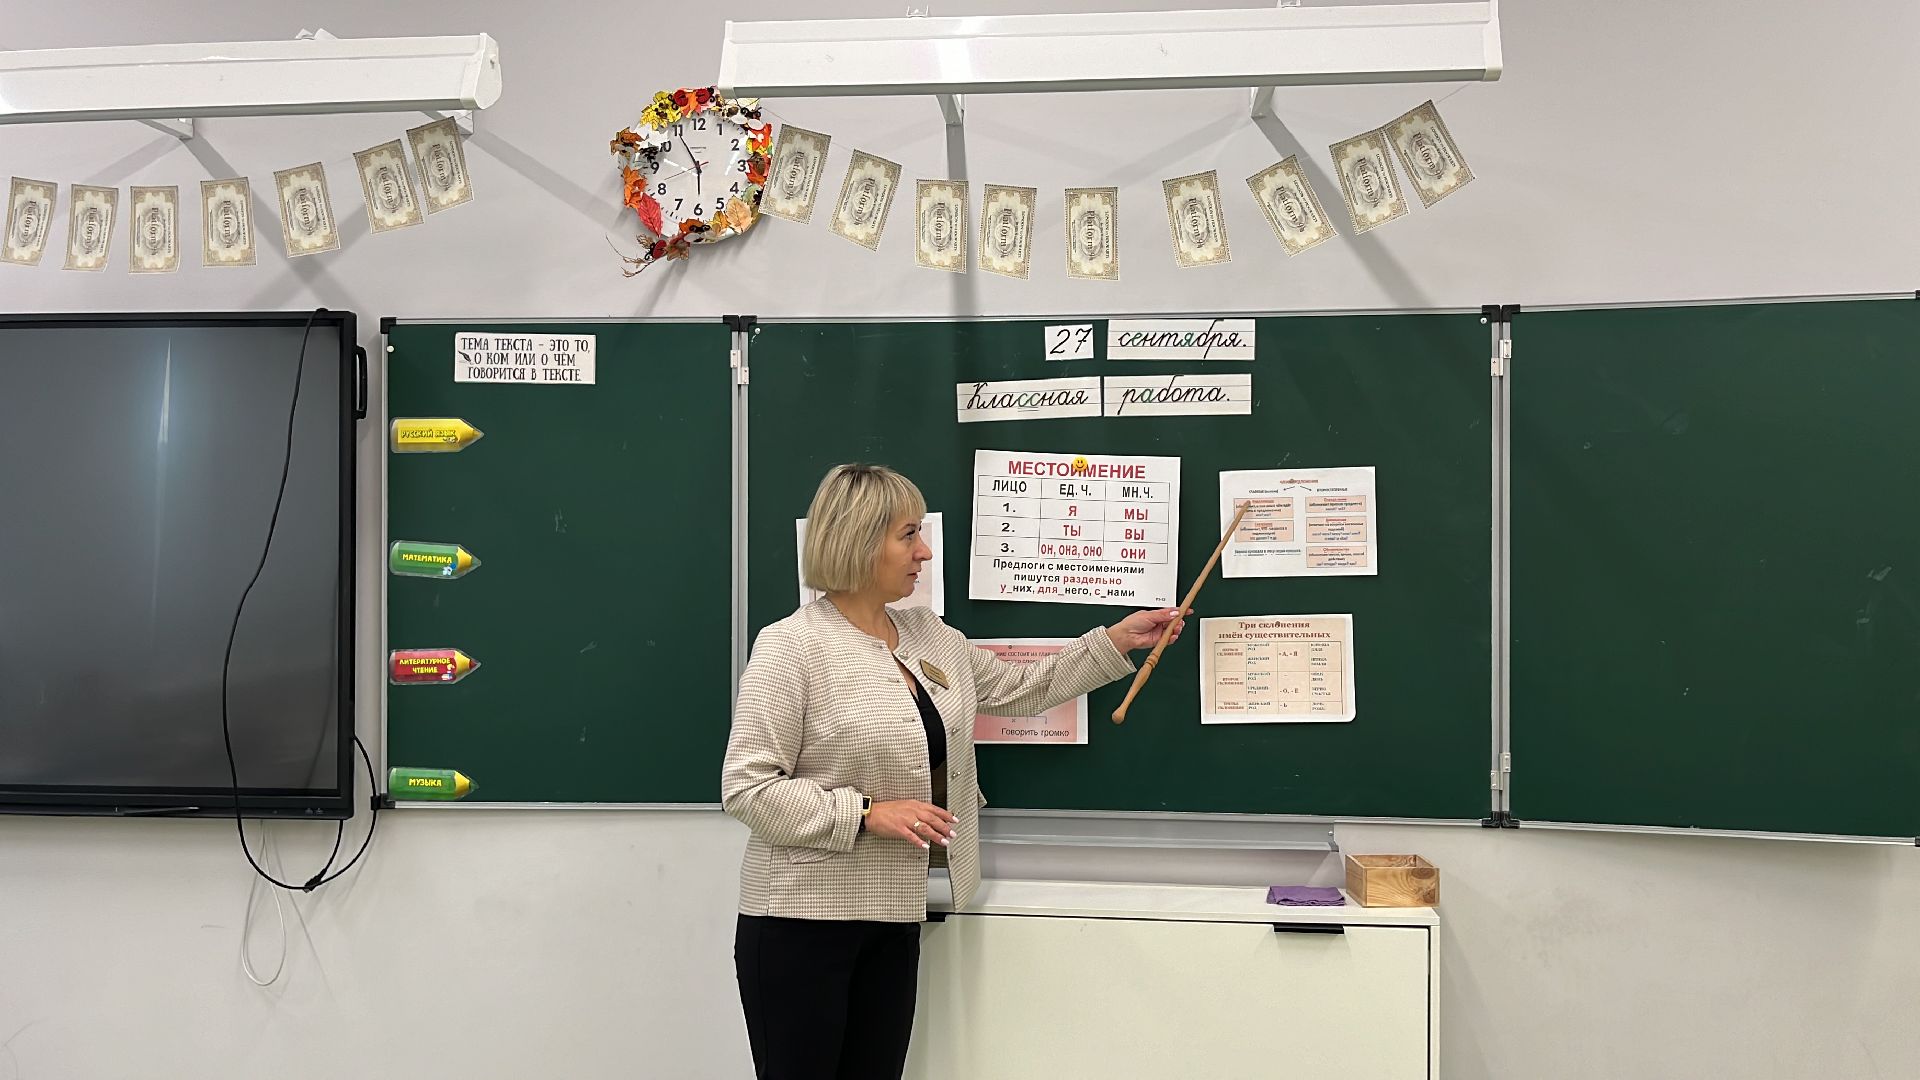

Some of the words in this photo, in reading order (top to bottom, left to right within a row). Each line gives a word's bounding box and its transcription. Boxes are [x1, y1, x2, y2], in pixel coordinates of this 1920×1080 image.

[672, 124, 683, 137] 11
[692, 118, 706, 131] 12
[717, 124, 723, 136] 1
[731, 139, 740, 151] 2
[1413, 132, 1436, 170] Platform
[651, 162, 660, 174] 9
[738, 160, 746, 172] 3
[789, 150, 804, 190] Platform
[1357, 157, 1374, 198] Platform
[657, 183, 667, 195] 8
[730, 182, 739, 194] 4
[856, 177, 875, 215] Platform
[674, 199, 683, 210] 7
[694, 203, 703, 216] 6
[716, 198, 725, 210] 5
[1275, 185, 1298, 224] Platform
[935, 202, 945, 240] Platform
[1189, 197, 1200, 237] Platform
[999, 208, 1012, 247] Platform
[1086, 210, 1096, 249] Platform
[461, 338, 489, 350] ТЕМА
[495, 338, 533, 351] ТЕКСТА
[549, 339, 569, 351] ЭТО
[574, 339, 590, 353] ТО,
[1050, 328, 1092, 354] 27
[1118, 319, 1247, 359] сентября.
[474, 352, 482, 365] О
[486, 352, 509, 365] КОМ
[515, 353, 536, 366] ИЛИ
[541, 353, 548, 366] О
[468, 367, 525, 380] ГОВОРИТСЯ
[531, 369, 537, 380] В
[966, 382, 1088, 412] Классная
[1117, 374, 1231, 415] работа.
[401, 429, 433, 438] РУССКИЙ
[1008, 460, 1146, 479] МЕСТОИМЕНИЕ
[992, 480, 1027, 493] ЛИЦО
[1059, 484, 1078, 497] ЕД.
[1081, 485, 1092, 496] Ч.
[1003, 502, 1016, 512] 1.
[1068, 505, 1077, 516] Я
[1124, 508, 1148, 520] МЫ
[1001, 522, 1015, 533] 2.
[1063, 524, 1081, 537] ТЫ
[1124, 528, 1145, 541] ВЫ
[1000, 542, 1014, 553] 3.
[402, 553, 452, 564] МАТЕМАТИКА
[993, 559, 1045, 572] Предлоги
[1056, 564, 1145, 574] местоимениями
[1014, 574, 1060, 584] пишутся
[1063, 576, 1122, 587] раздельно
[1239, 621, 1256, 630] Три
[1245, 632, 1331, 640] существительных
[400, 657, 451, 665] ЛИТЕРАТУРНОЕ
[1001, 728, 1039, 738] Говорить
[1041, 730, 1070, 738] громко
[408, 778, 442, 787] МУЗЫКА
